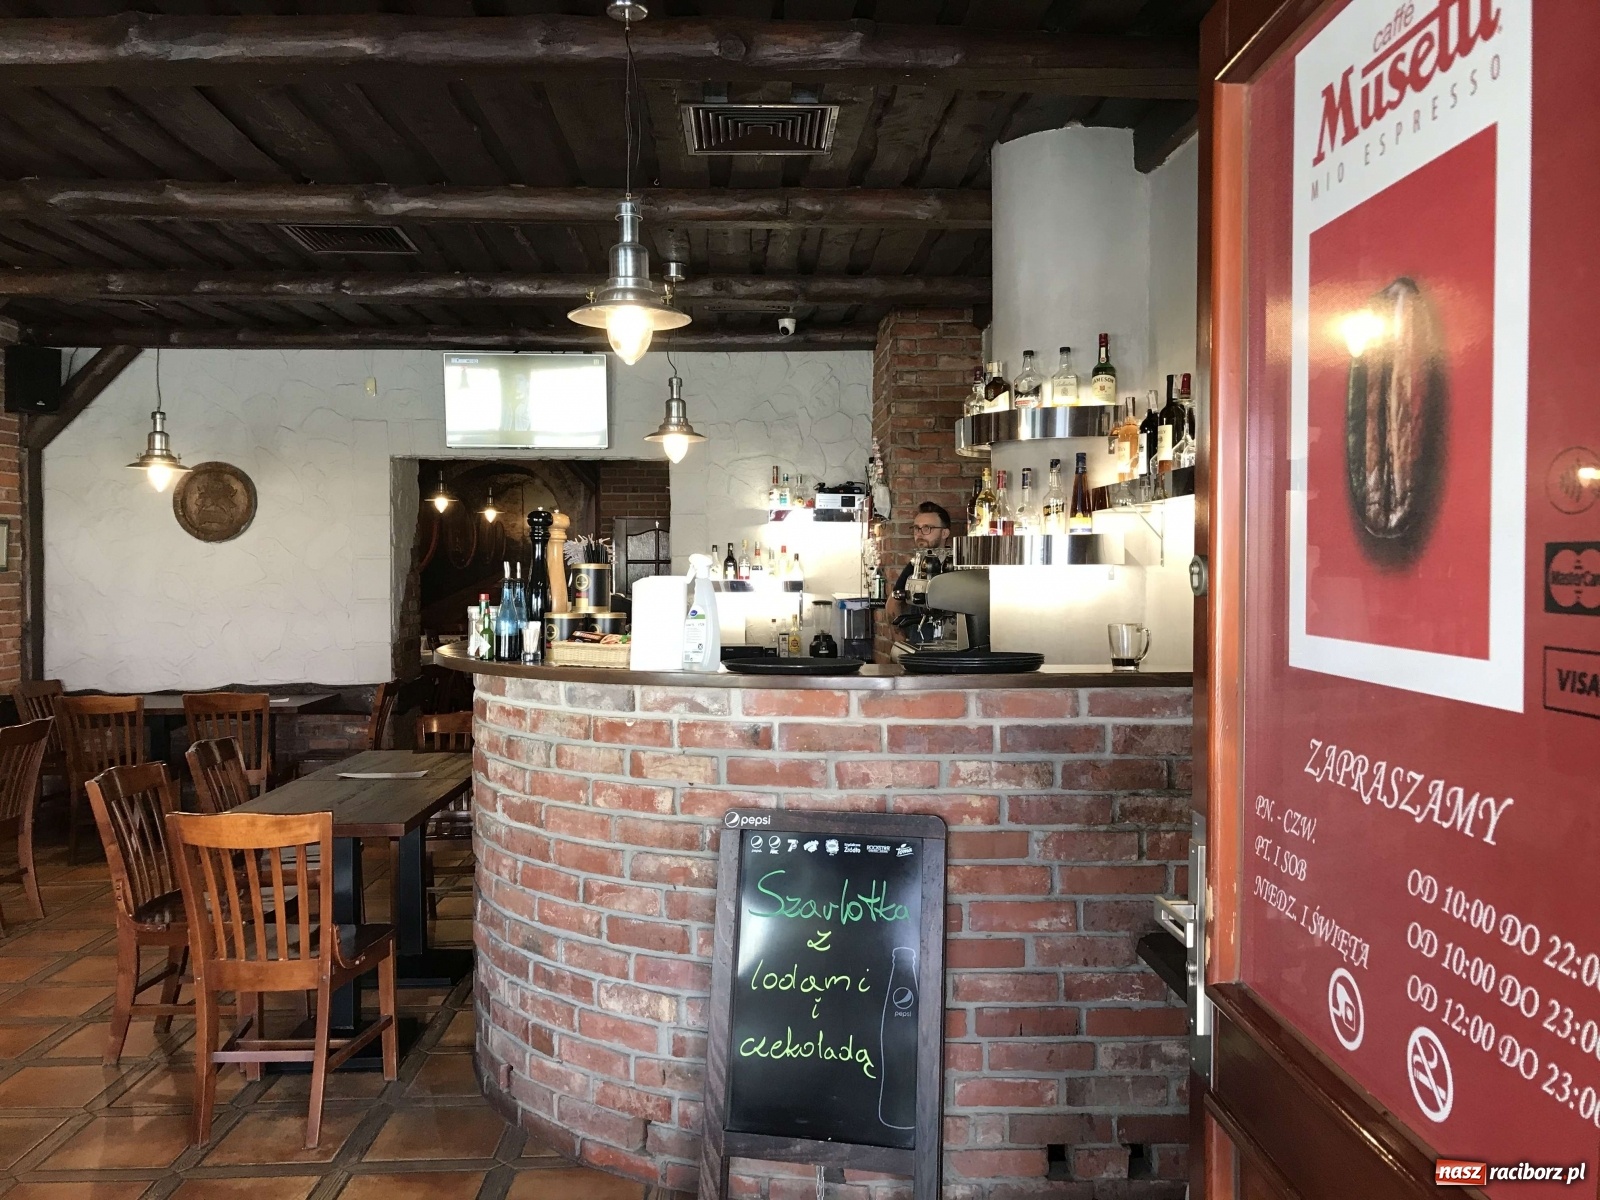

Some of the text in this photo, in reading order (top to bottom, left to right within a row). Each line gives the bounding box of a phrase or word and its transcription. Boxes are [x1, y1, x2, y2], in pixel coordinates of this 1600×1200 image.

[1311, 54, 1500, 201] MIO ESPRESSO
[741, 815, 771, 827] pepsi
[1255, 795, 1275, 822] PN.
[1283, 809, 1317, 844] CZW.
[1304, 738, 1514, 846] ZAPRASZAMY
[1255, 835, 1307, 881] PT. I SOB
[1254, 875, 1370, 970] NIEDZ. I ŚWIĘTA
[1407, 868, 1600, 993] OD 10:00 DO 22:0
[1407, 922, 1438, 958] OD
[1441, 942, 1496, 993] 10:00
[1499, 974, 1540, 1018] DO
[739, 1026, 876, 1079] czekoladą
[811, 997, 821, 1019] i
[1407, 974, 1438, 1012] OD
[1441, 998, 1495, 1051] 12:00
[1498, 1034, 1539, 1080] DO
